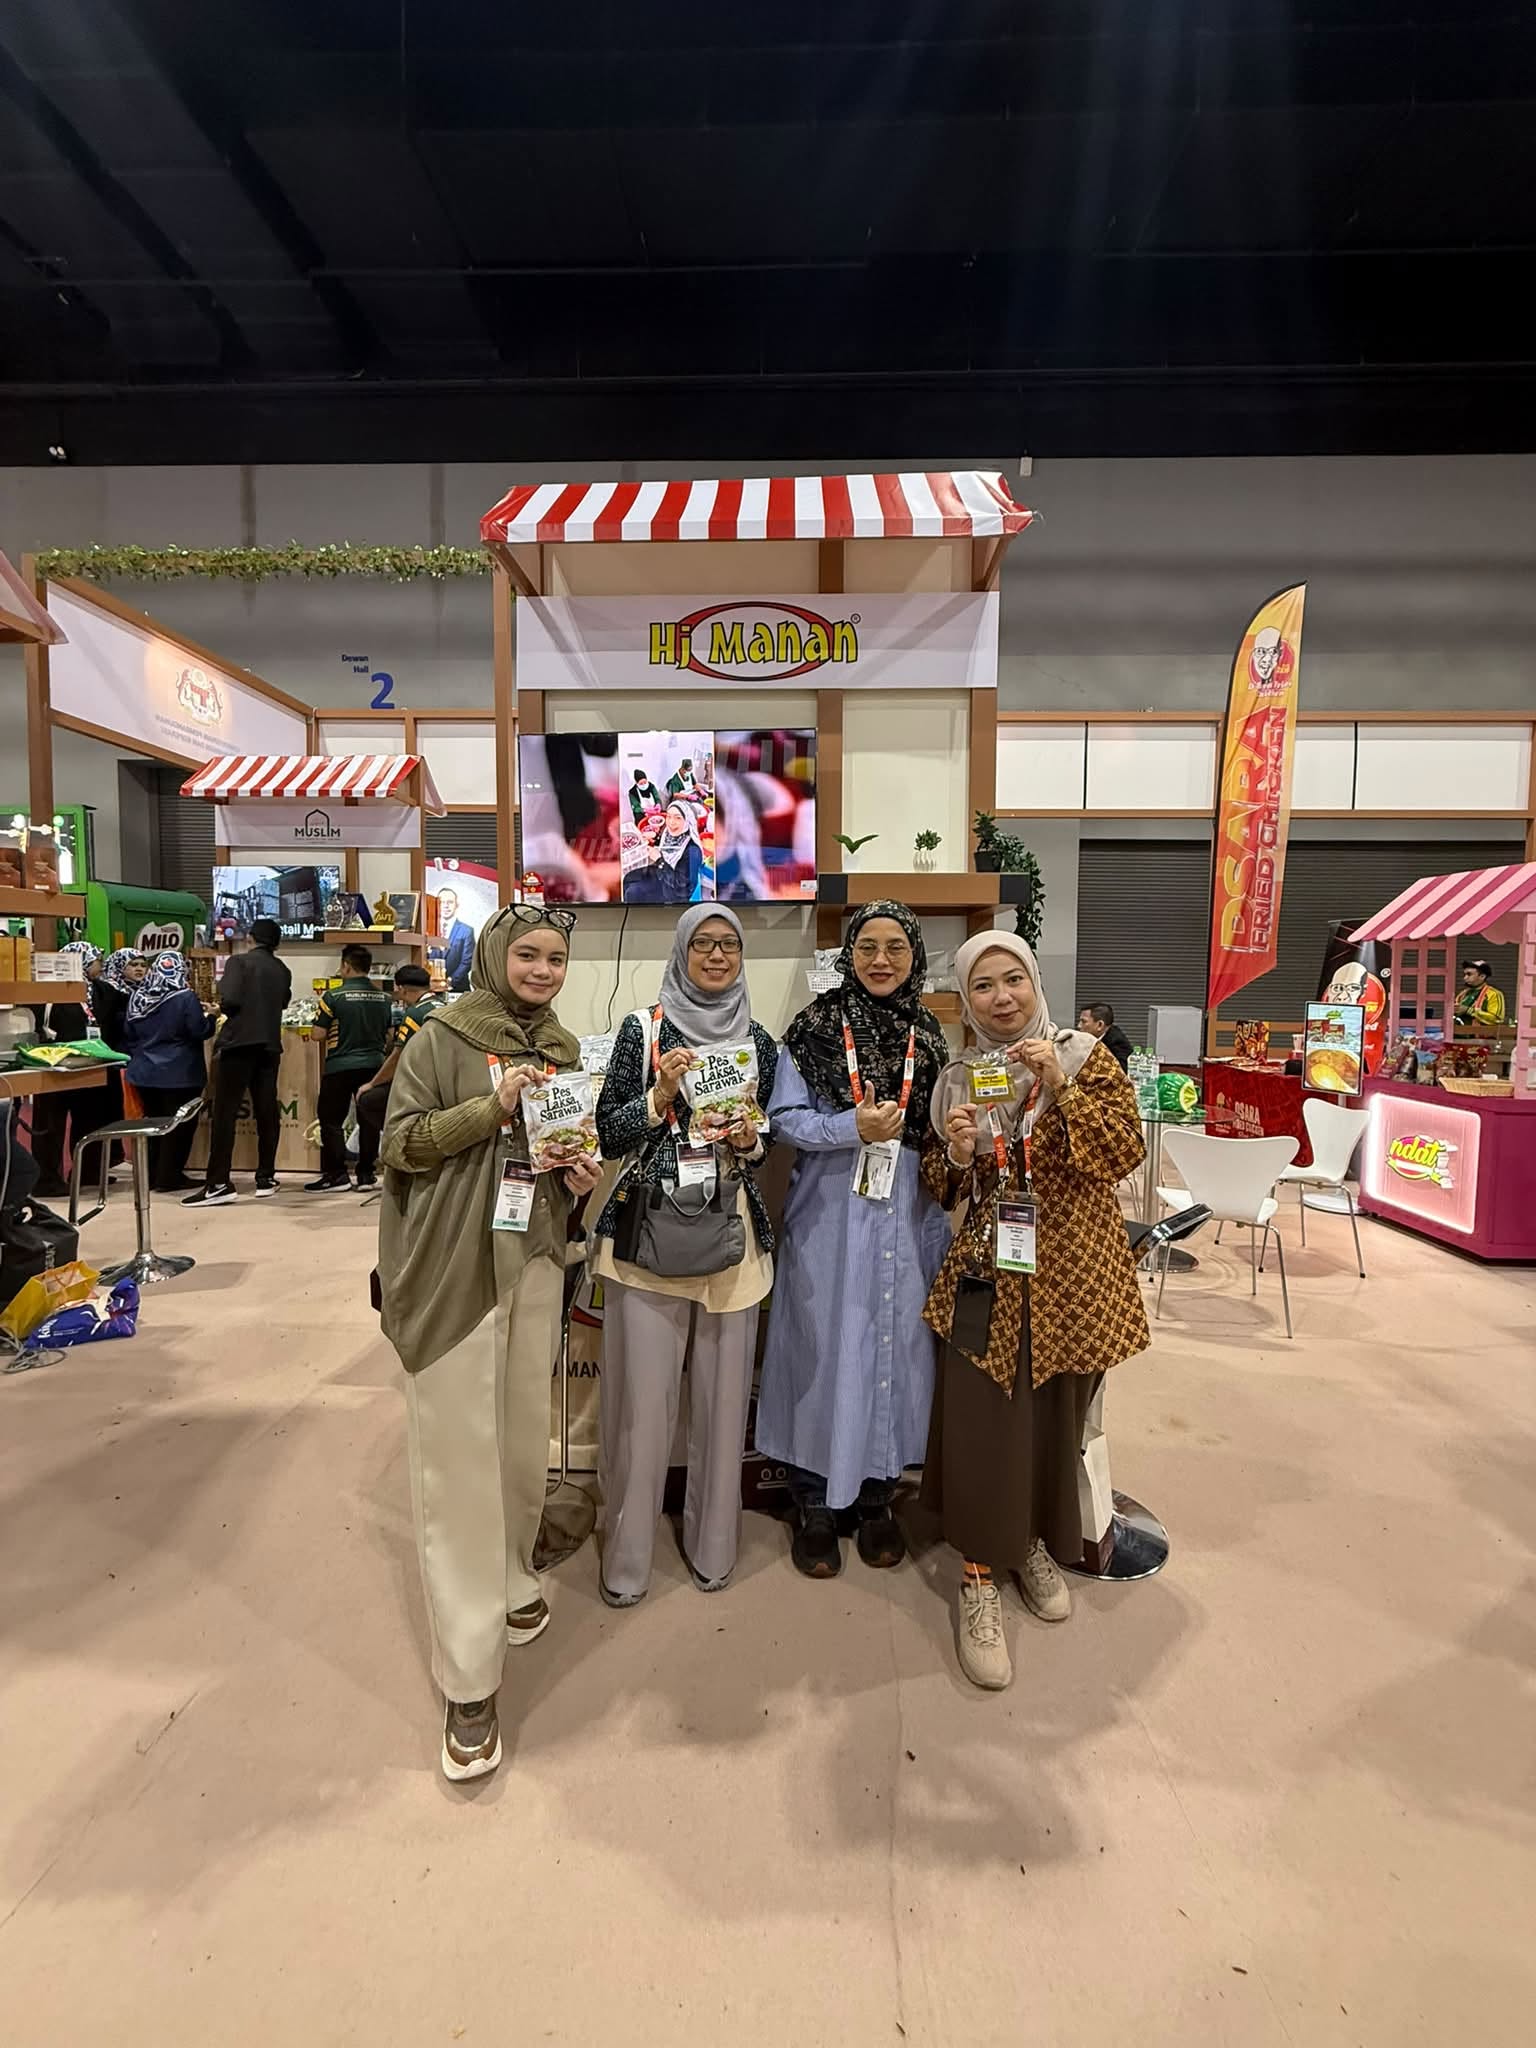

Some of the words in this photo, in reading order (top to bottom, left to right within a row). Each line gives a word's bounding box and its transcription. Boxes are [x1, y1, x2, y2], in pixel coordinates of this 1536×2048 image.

[650, 622, 692, 670] Hj
[708, 620, 858, 665] Manan
[371, 672, 395, 709] 2
[295, 827, 341, 837] MUSLIM
[1250, 855, 1275, 953] FRIED
[142, 933, 180, 951] MILO
[707, 1055, 729, 1070] Pes
[695, 1070, 746, 1096] Sarawak
[700, 1065, 736, 1083] Laksa
[552, 1087, 571, 1099] Pes
[540, 1101, 583, 1123] Sarawak
[545, 1096, 576, 1111] Laksa
